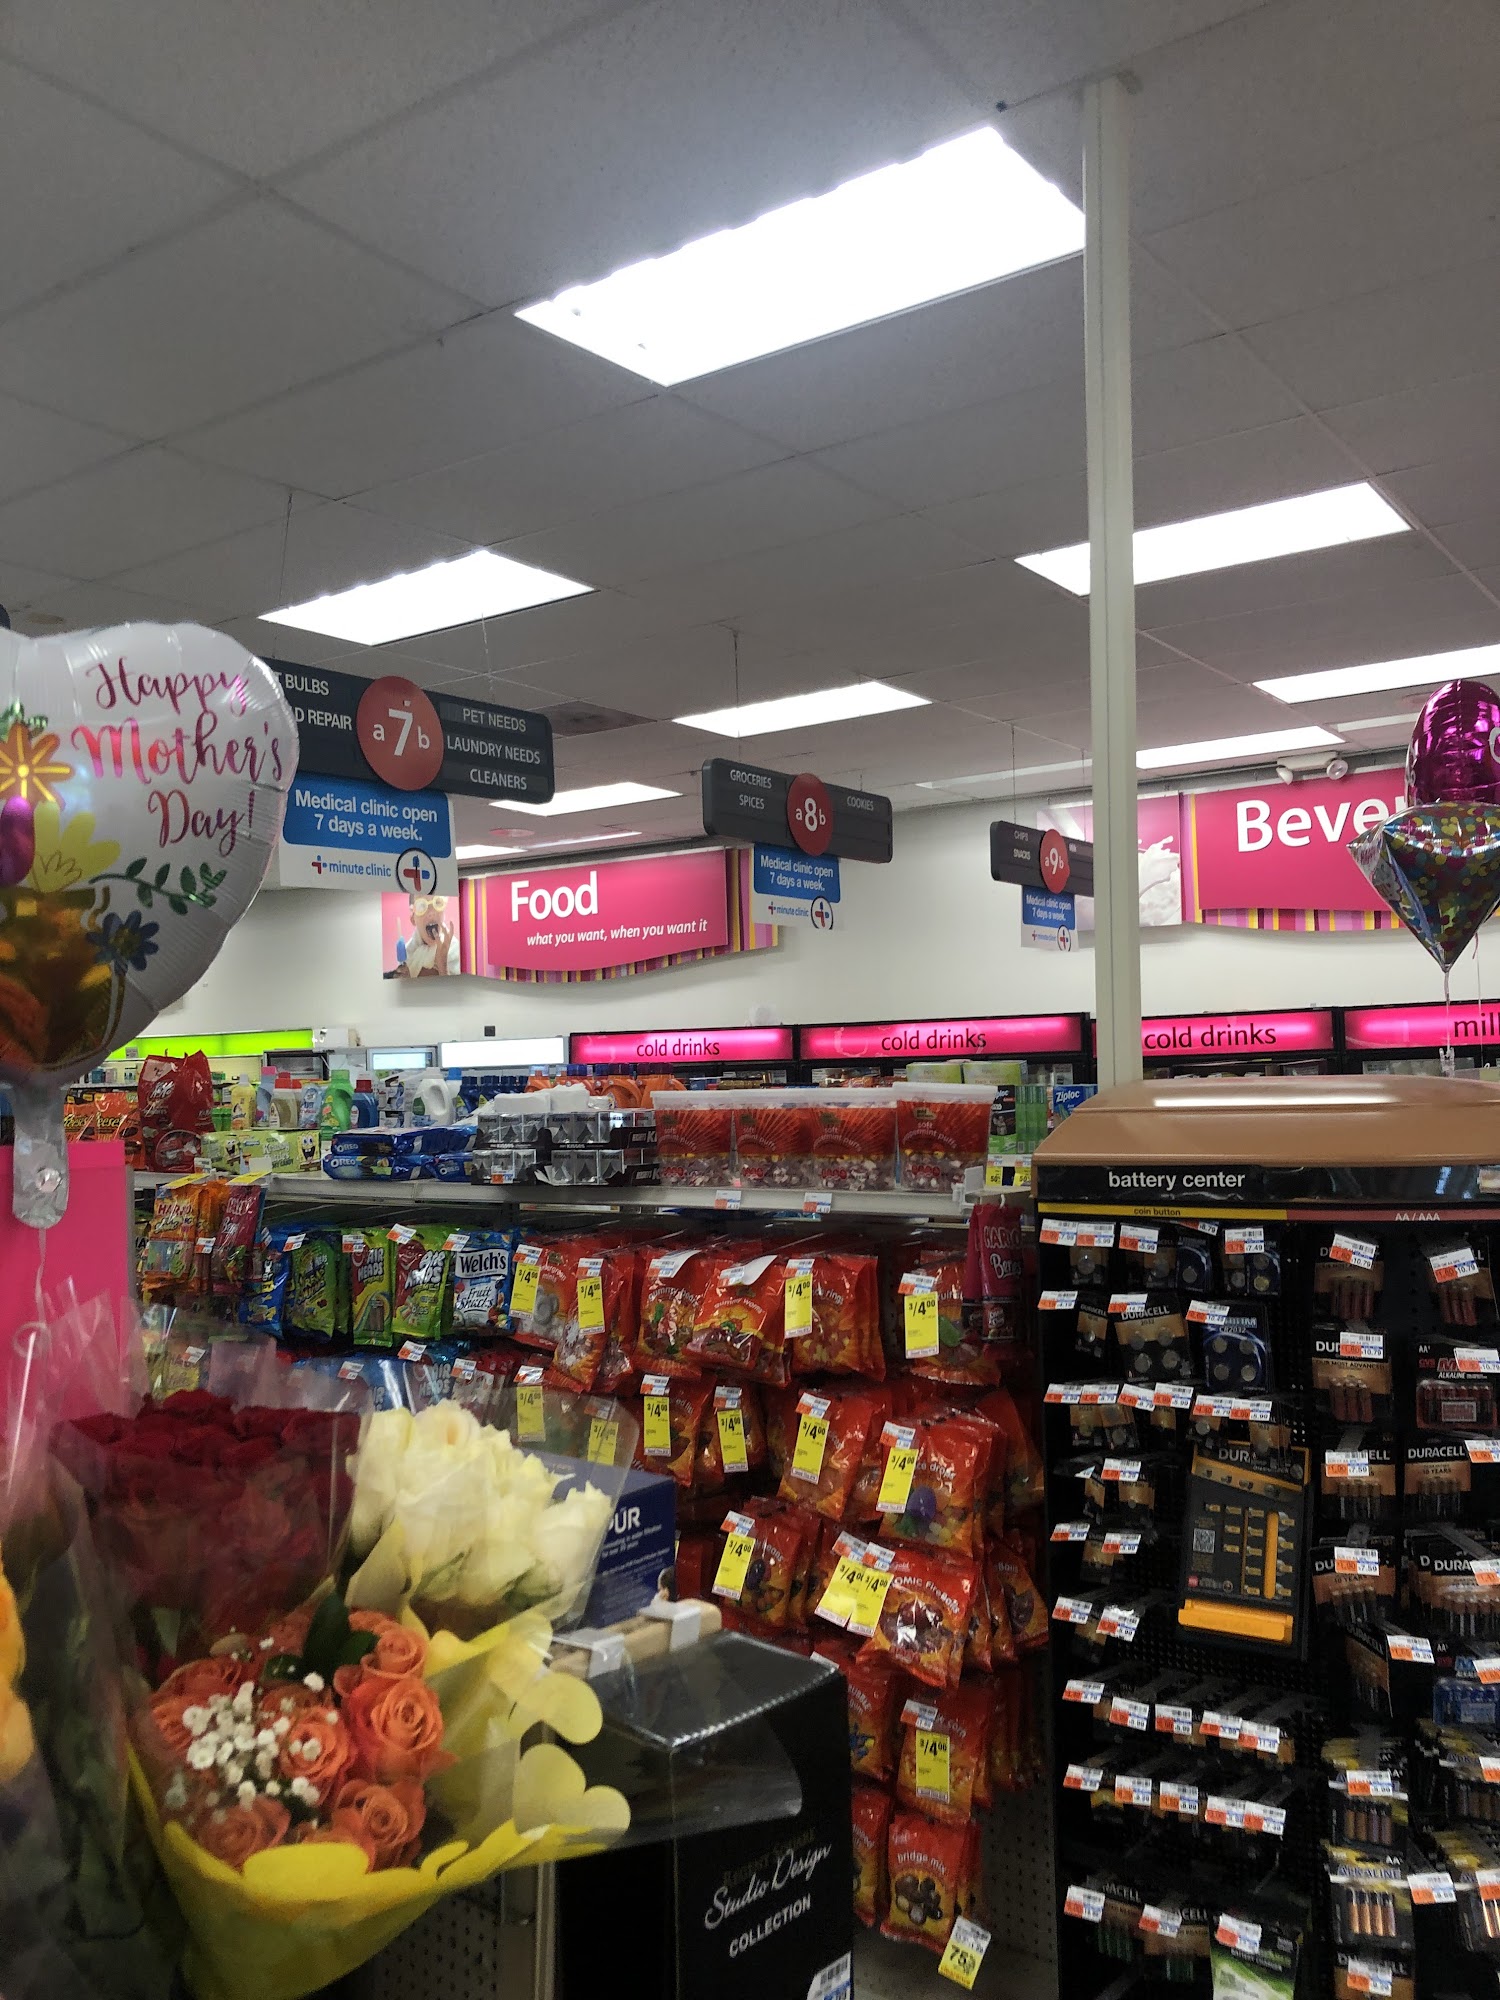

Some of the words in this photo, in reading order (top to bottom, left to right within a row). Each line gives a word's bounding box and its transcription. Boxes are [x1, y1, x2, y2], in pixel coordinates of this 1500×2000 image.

[86, 656, 249, 717] Happy
[285, 674, 329, 696] BULBS
[307, 709, 352, 731] REPAIR
[463, 708, 485, 724] PET
[488, 712, 527, 732] NEEDS
[71, 710, 282, 785] Mother's
[447, 735, 502, 757] LAUNDRY
[505, 746, 540, 764] NEEDS
[470, 768, 527, 790] CLEANERS
[730, 769, 772, 789] GROCERIES
[295, 789, 356, 813] Medical
[360, 799, 399, 818] clinic
[402, 807, 438, 823] open
[739, 794, 765, 810] SPICES
[846, 796, 875, 812] COOKIES
[148, 789, 255, 857] Day!
[314, 814, 324, 830] 7
[328, 815, 364, 837] days
[368, 826, 377, 836] a
[380, 824, 423, 841] week.
[329, 860, 364, 875] minute
[365, 864, 392, 877] clinic
[760, 855, 792, 871] Medical
[792, 860, 813, 875] clinic
[814, 865, 834, 878] open
[770, 872, 775, 884] 7
[776, 872, 795, 889] days
[796, 879, 802, 888] a
[803, 878, 826, 892] week.
[511, 870, 598, 922] Food
[527, 932, 552, 946] what
[554, 931, 574, 947] you
[577, 928, 608, 942] want,
[610, 925, 640, 940] when
[642, 923, 664, 940] you
[666, 920, 696, 934] want
[699, 918, 708, 932] it
[881, 1030, 921, 1053] cold
[926, 1027, 986, 1050] drinks
[1144, 1025, 1192, 1049] cold
[1200, 1023, 1277, 1047] drinks
[636, 1039, 668, 1058] cold
[672, 1037, 720, 1057] drinks
[1055, 1090, 1080, 1103] Ziploc
[824, 1125, 838, 1133] soft
[918, 1121, 933, 1129] soft
[938, 1132, 957, 1149] puffs
[330, 1158, 356, 1168] OREO
[1108, 1171, 1177, 1191] battery
[1182, 1171, 1246, 1188] center
[1133, 1207, 1151, 1215] coin
[1152, 1207, 1181, 1216] button
[1395, 1212, 1410, 1221] AA
[1418, 1212, 1440, 1221] AAA
[366, 1248, 383, 1264] AIR
[419, 1250, 446, 1270] AIR
[459, 1254, 507, 1274] Welch's
[357, 1263, 383, 1282] HEADS
[468, 1286, 491, 1299] Fruit
[826, 1289, 844, 1305] rings
[1408, 1446, 1465, 1459] DURACELL
[897, 1852, 928, 1865] bridge
[930, 1857, 947, 1875] mix
[704, 1872, 770, 1930] Studio
[772, 1844, 831, 1890] Design
[729, 1893, 811, 1959] COLLECTION
